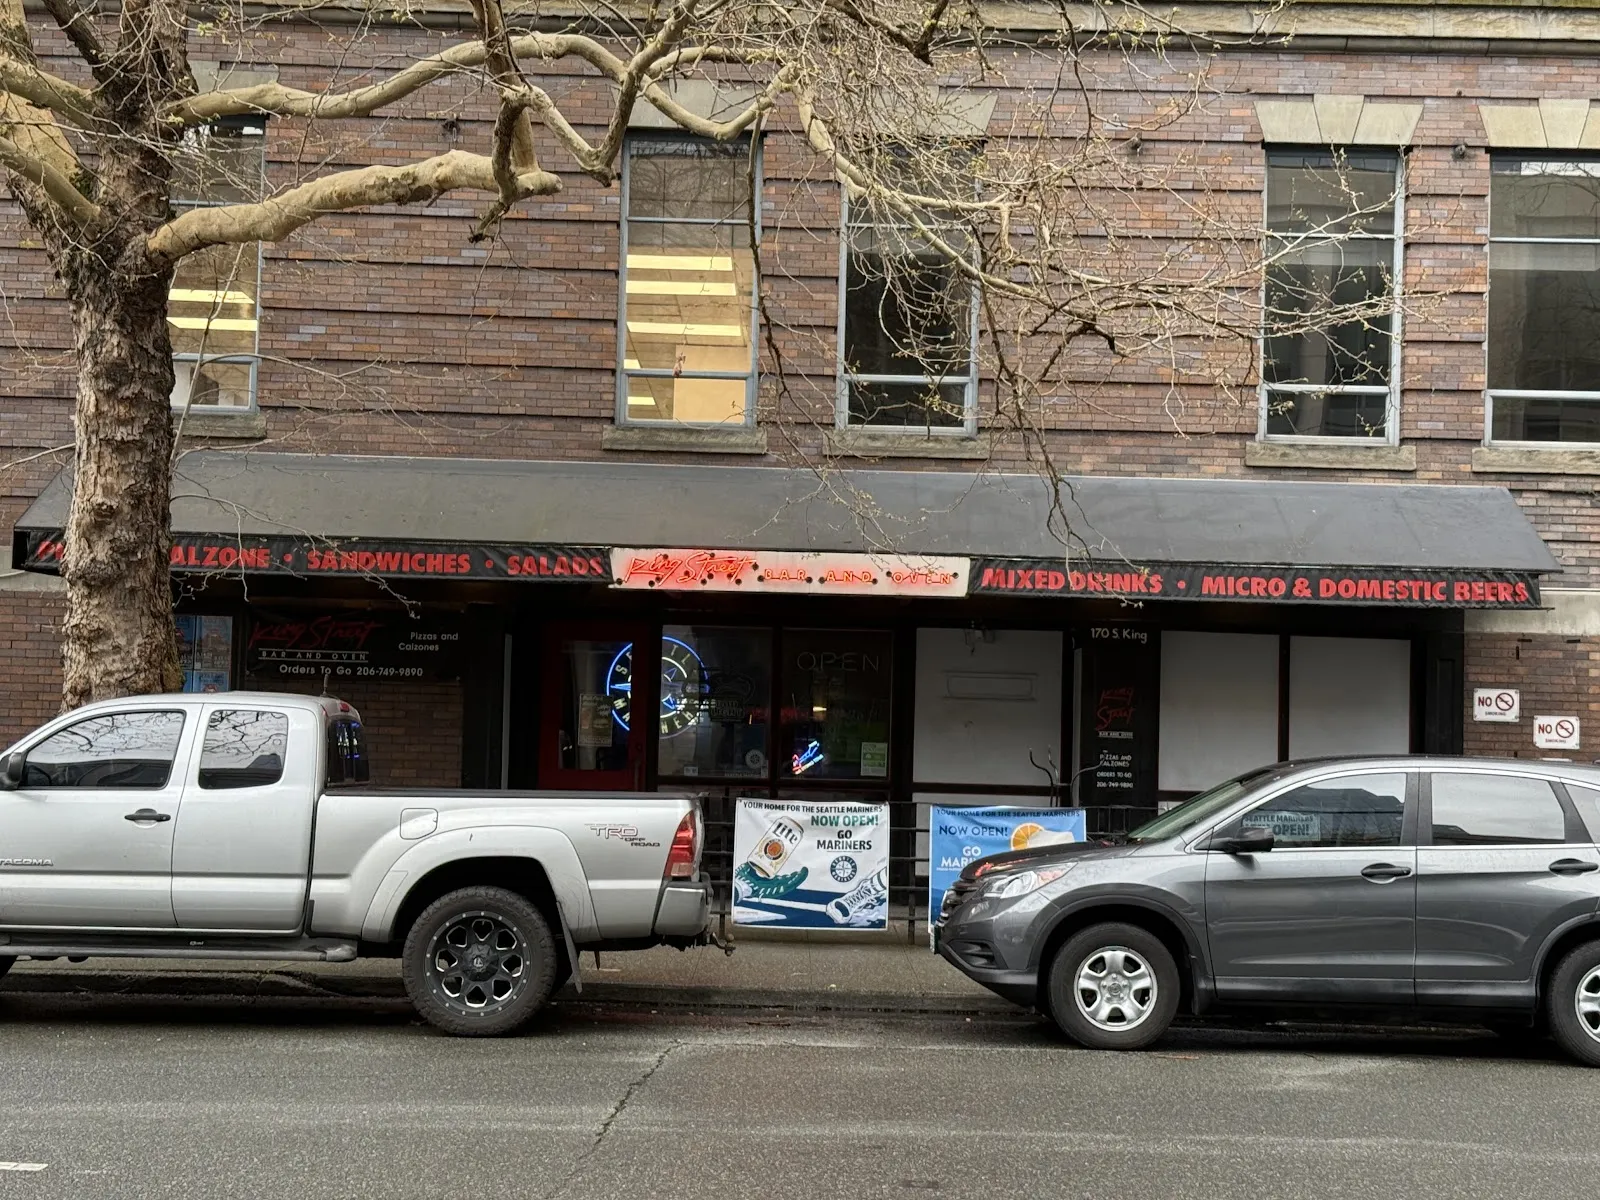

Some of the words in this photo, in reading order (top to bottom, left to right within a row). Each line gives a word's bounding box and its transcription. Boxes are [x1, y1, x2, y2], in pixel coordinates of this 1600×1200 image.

[170, 545, 270, 568] ALZONE
[307, 551, 471, 573] SANDWICHES
[507, 555, 604, 576] SALADS
[624, 552, 683, 586] King
[677, 551, 757, 583] Street
[765, 568, 806, 580] BAR
[826, 570, 873, 583] AND
[892, 571, 951, 584] OVEN
[981, 568, 1065, 590] MIXED
[1070, 571, 1163, 594] DRINKS
[1201, 575, 1286, 597] MICRO
[1293, 577, 1312, 597] &
[1319, 578, 1447, 600] DOMESTIC
[1454, 582, 1529, 602] BEERS
[410, 632, 437, 641] Pizzas
[440, 632, 459, 641] and
[1090, 628, 1110, 639] 170
[1122, 629, 1148, 644] King
[398, 642, 440, 652] Calzones
[296, 652, 322, 660] AND
[331, 653, 366, 661] OVEN
[797, 651, 879, 674] OPEN
[279, 664, 316, 675] Orders
[320, 666, 332, 676] To
[336, 667, 352, 676] Go
[356, 667, 423, 677] 206-749-9890
[1478, 697, 1492, 707] NO
[1538, 724, 1552, 734] NO
[743, 801, 763, 809] YOUR
[764, 803, 785, 811] HOME
[937, 808, 957, 816] YOUR
[811, 815, 840, 826] NOW
[843, 815, 879, 826] OPEN!
[590, 826, 638, 840] TRD
[772, 822, 798, 845] Lite
[837, 830, 853, 839] GO
[939, 825, 968, 836] NOW
[971, 827, 1008, 837] OPEN!
[1272, 824, 1310, 836] OPEN!
[816, 840, 872, 850] MARINERS
[962, 846, 982, 857] GO
[0, 858, 54, 867] TACOMA
